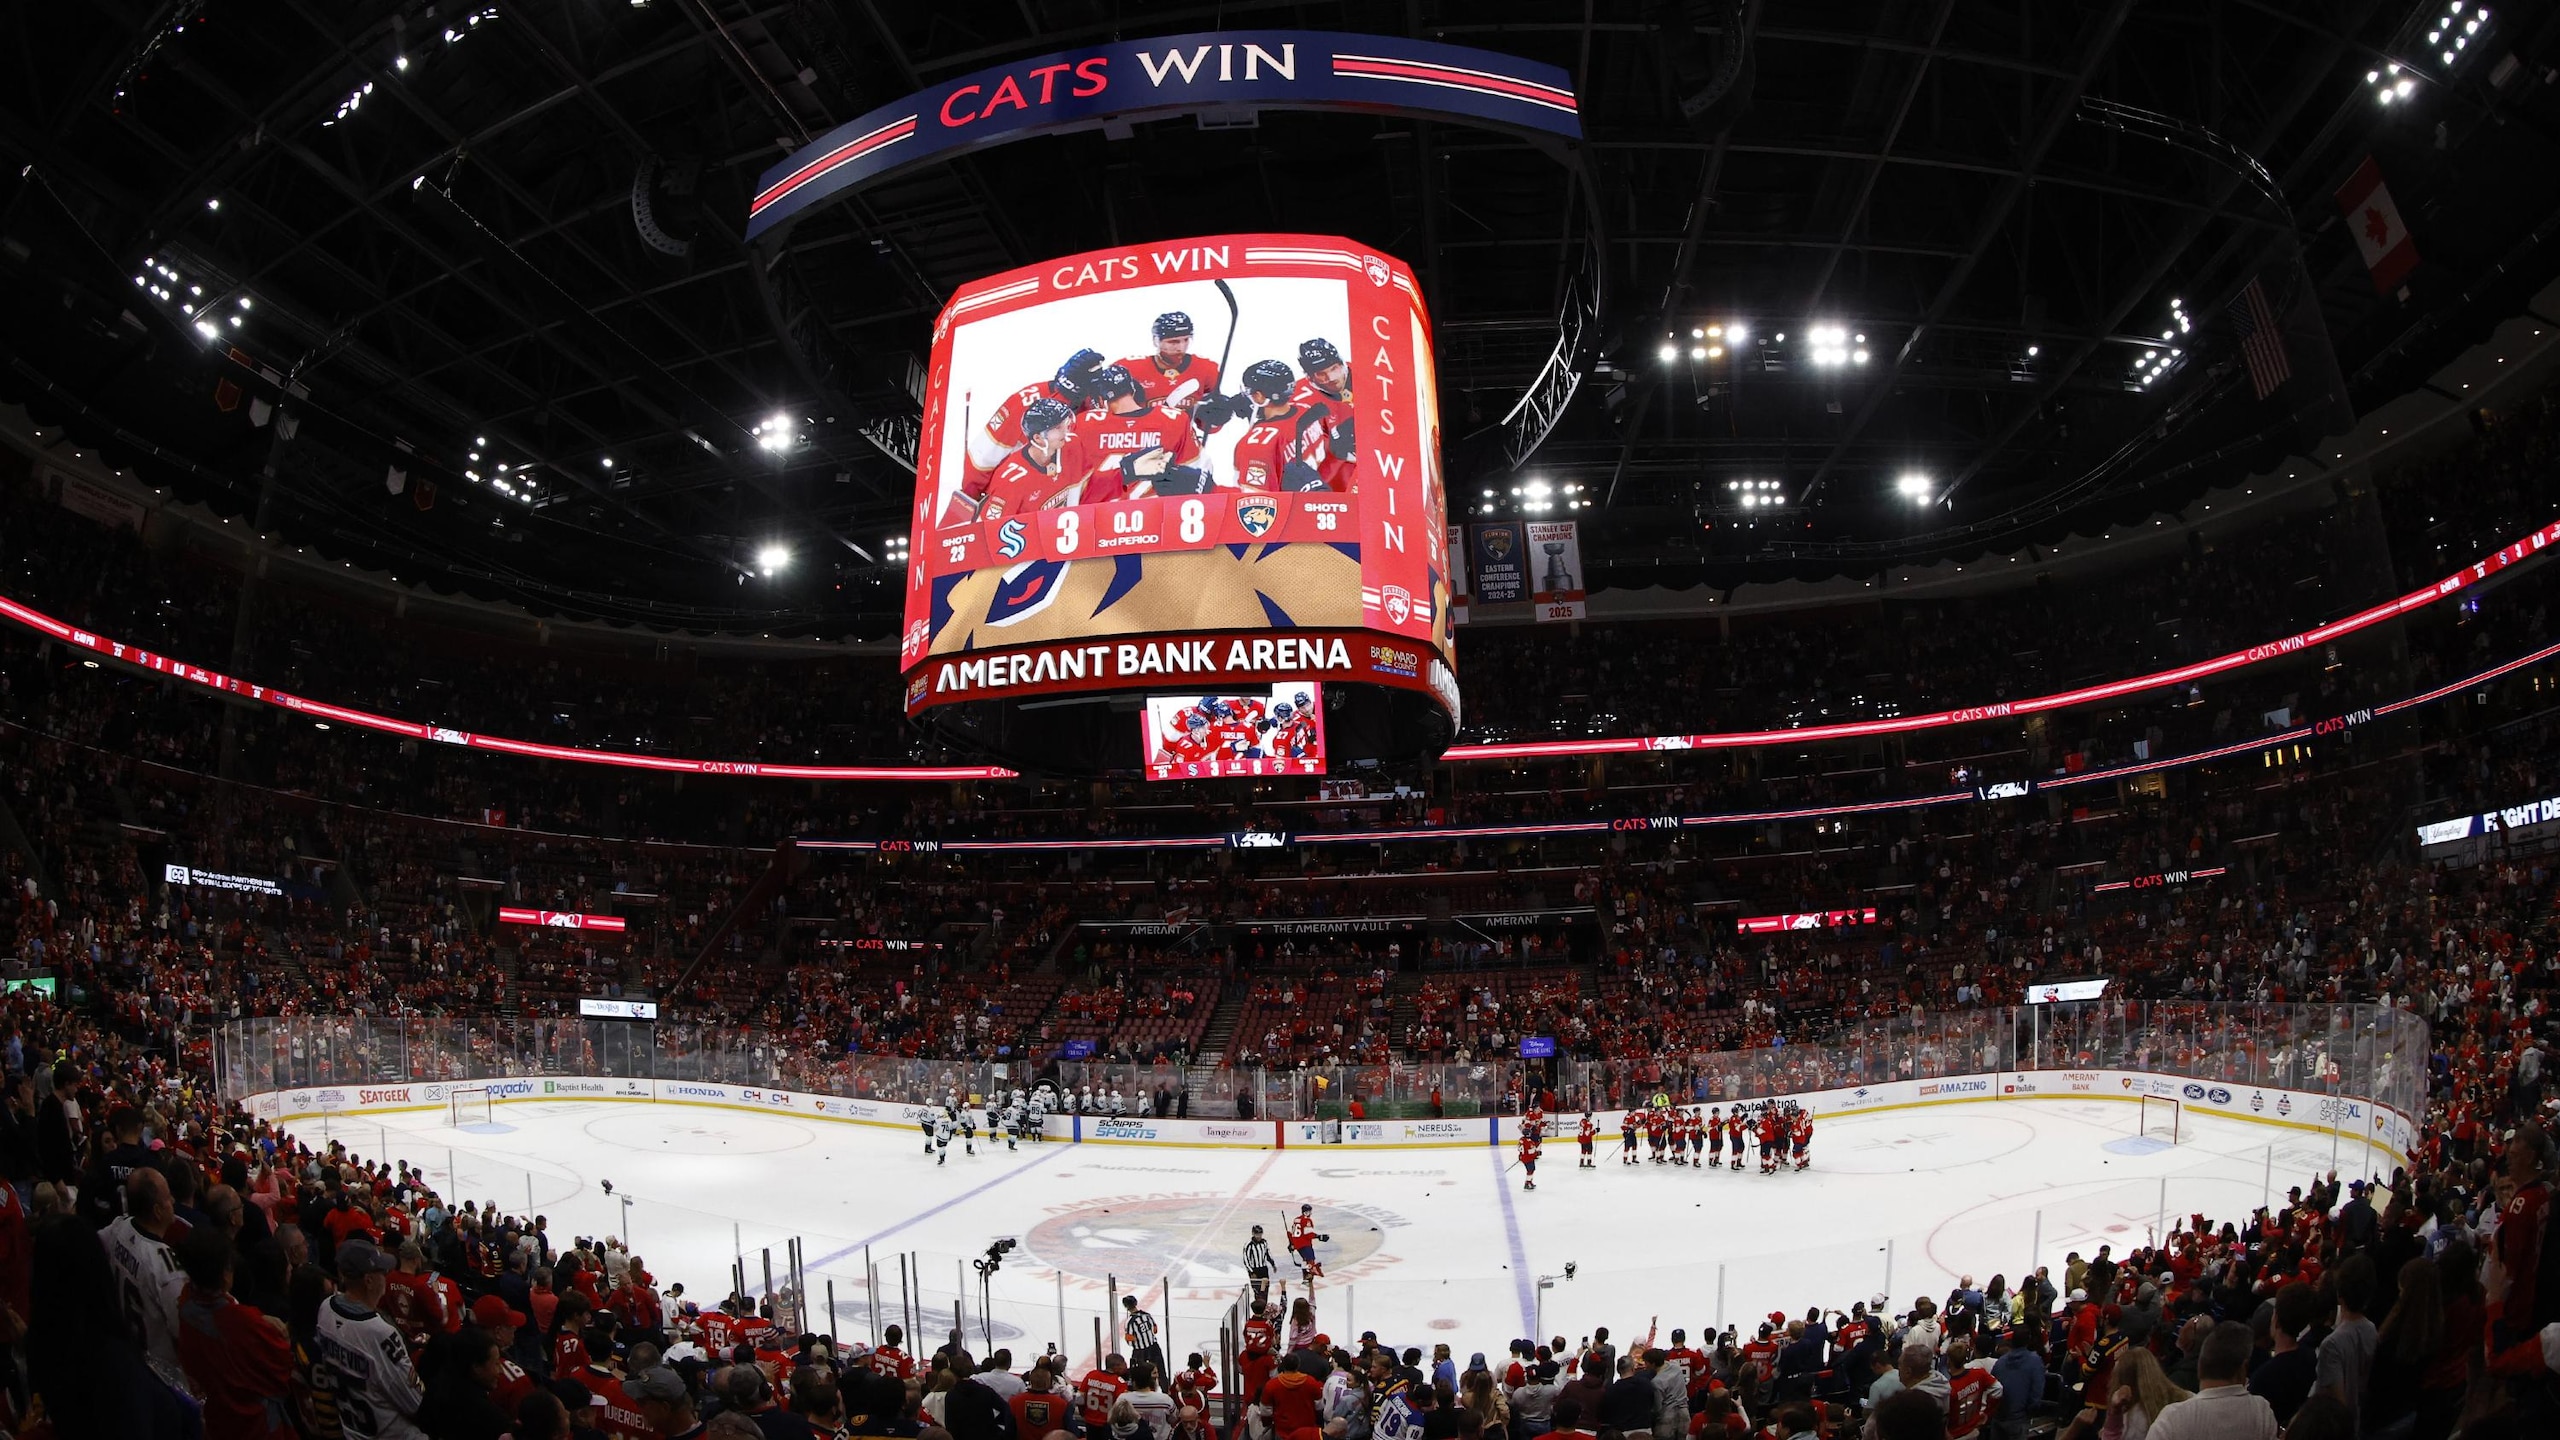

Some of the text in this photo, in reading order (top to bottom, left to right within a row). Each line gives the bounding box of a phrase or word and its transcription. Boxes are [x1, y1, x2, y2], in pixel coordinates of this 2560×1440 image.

[939, 43, 1295, 127] CATS WIN
[1052, 245, 1229, 290] CATS WIN
[1100, 431, 1162, 450] FORSLING
[1246, 426, 1279, 445] 27
[1372, 315, 1405, 554] CATS WIN
[914, 364, 943, 591] CATS WIN
[1000, 462, 1028, 483] 77
[1304, 503, 1348, 513] SHOTS
[1113, 509, 1144, 534] 0.0
[1179, 499, 1205, 544] 8
[1316, 514, 1337, 531] 38
[1056, 511, 1079, 554] 3
[1529, 523, 1574, 535] STANLEY CUP
[942, 533, 976, 547] SHOTS
[1098, 534, 1159, 548] 3rd PERIOD
[1532, 532, 1573, 542] CHAMPIONS
[950, 545, 965, 563] 23
[1485, 564, 1514, 573] EASTERN
[1479, 572, 1521, 582] CONFERENCE
[1481, 581, 1520, 591] CHAMPIONS
[1487, 591, 1516, 600] 2024-25
[1548, 606, 1573, 618] 2025
[2248, 635, 2306, 662] CATS WIN
[935, 645, 1111, 693] AMERANT
[1117, 640, 1216, 676] BANK
[1227, 638, 1353, 671] ARENA
[1952, 704, 2011, 723] CATS WIN
[2315, 708, 2371, 735] CATS WIN
[702, 761, 758, 775] CATS WIN
[1210, 761, 1220, 776] 3
[1613, 816, 1678, 831] CATS WIN
[880, 840, 938, 852] CATS WIN
[2134, 871, 2188, 889] CATS WIN
[1273, 921, 1391, 934] THE AMERANT VAULT
[1485, 915, 1540, 926] AMERANT
[1130, 925, 1182, 935] AMERANT
[856, 939, 908, 951] CATS WIN
[2062, 1073, 2100, 1082] AMERANT
[486, 1080, 534, 1097] payactiv
[556, 1082, 604, 1093] Baptist Health
[679, 1086, 726, 1098] HONDA
[1939, 1080, 1988, 1094] AMAZING
[2015, 1083, 2036, 1093] YouTube
[2072, 1083, 2090, 1091] BANK
[359, 1087, 411, 1105] SEATGEEK
[2345, 1103, 2362, 1120] XL
[1098, 1119, 1144, 1129] SCRIPPS
[1095, 1127, 1158, 1139] SPORTS
[1232, 1127, 1248, 1137] hair
[562, 1338, 579, 1354] 27
[708, 1329, 725, 1349] 19
[1087, 1391, 1114, 1411] 63
